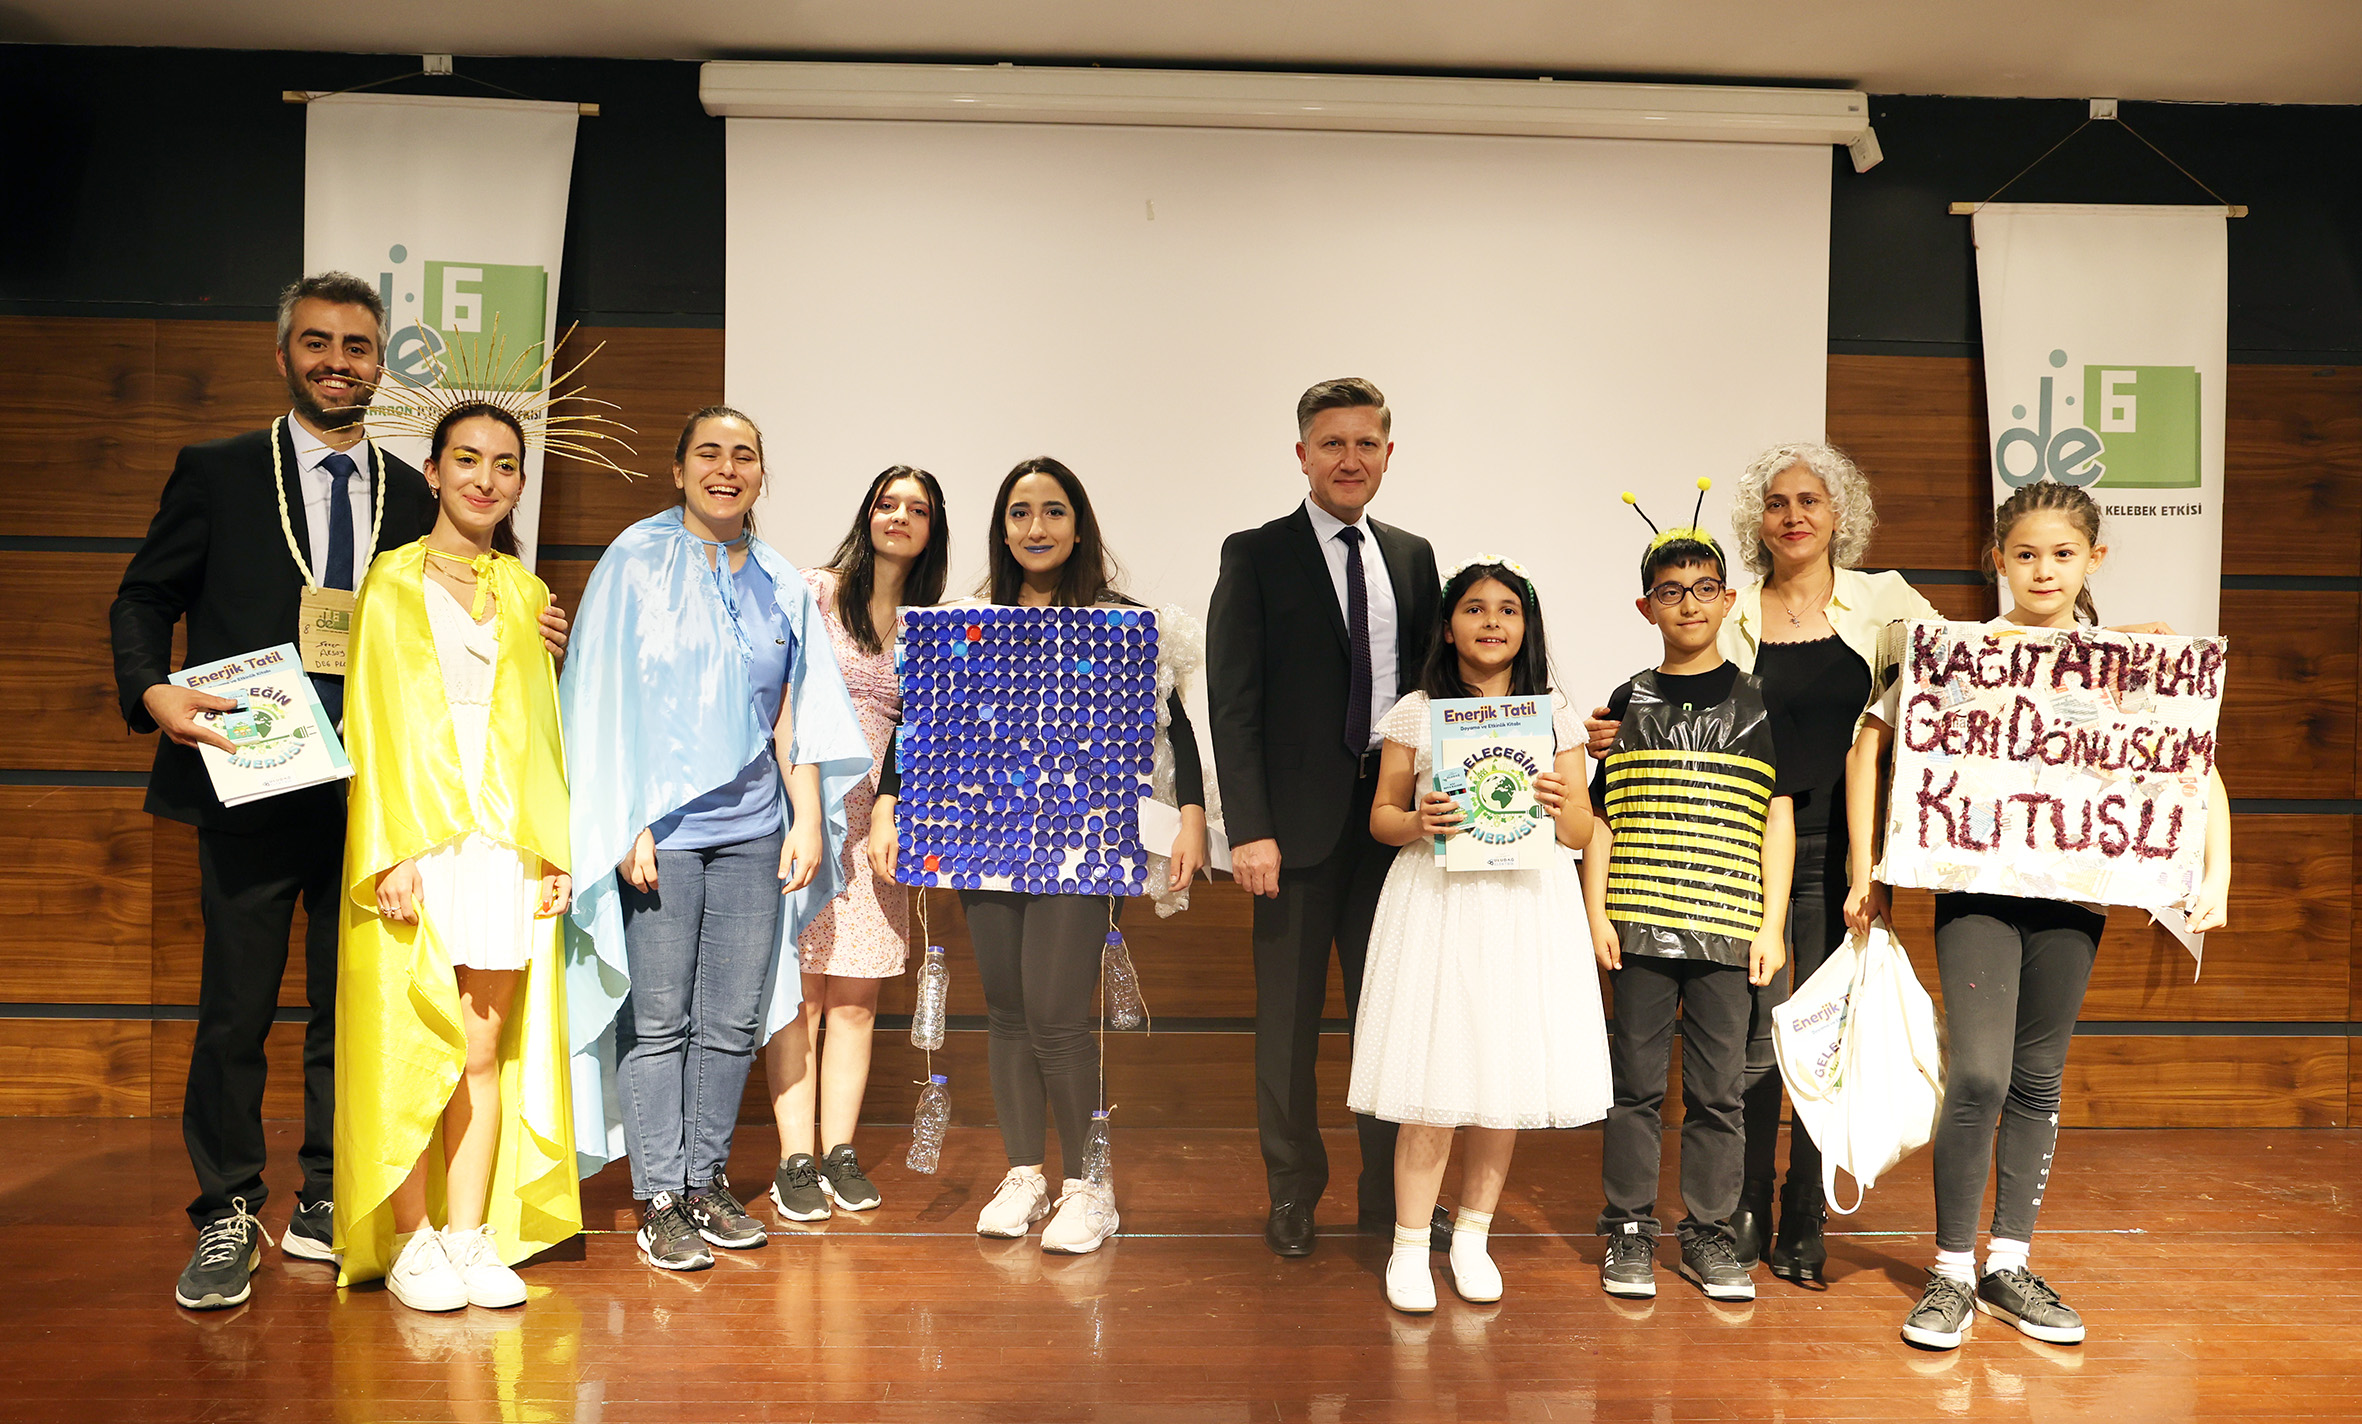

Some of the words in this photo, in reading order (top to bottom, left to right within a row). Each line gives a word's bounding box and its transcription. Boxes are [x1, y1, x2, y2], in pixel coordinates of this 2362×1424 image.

[2105, 505, 2157, 516] KELEBEK
[2161, 502, 2202, 516] ETKİSİ
[186, 663, 244, 688] Enerjik
[244, 651, 284, 669] Tatil
[1913, 624, 2055, 688] KAĞIT
[1444, 705, 1498, 723] Enerjik
[1500, 701, 1537, 717] Tatil
[1463, 746, 1539, 777] ELECEĞİN
[1916, 767, 2184, 863] KUTUSU
[1472, 818, 1537, 845] NERJİSİ
[1792, 1002, 1840, 1033] Enerjik
